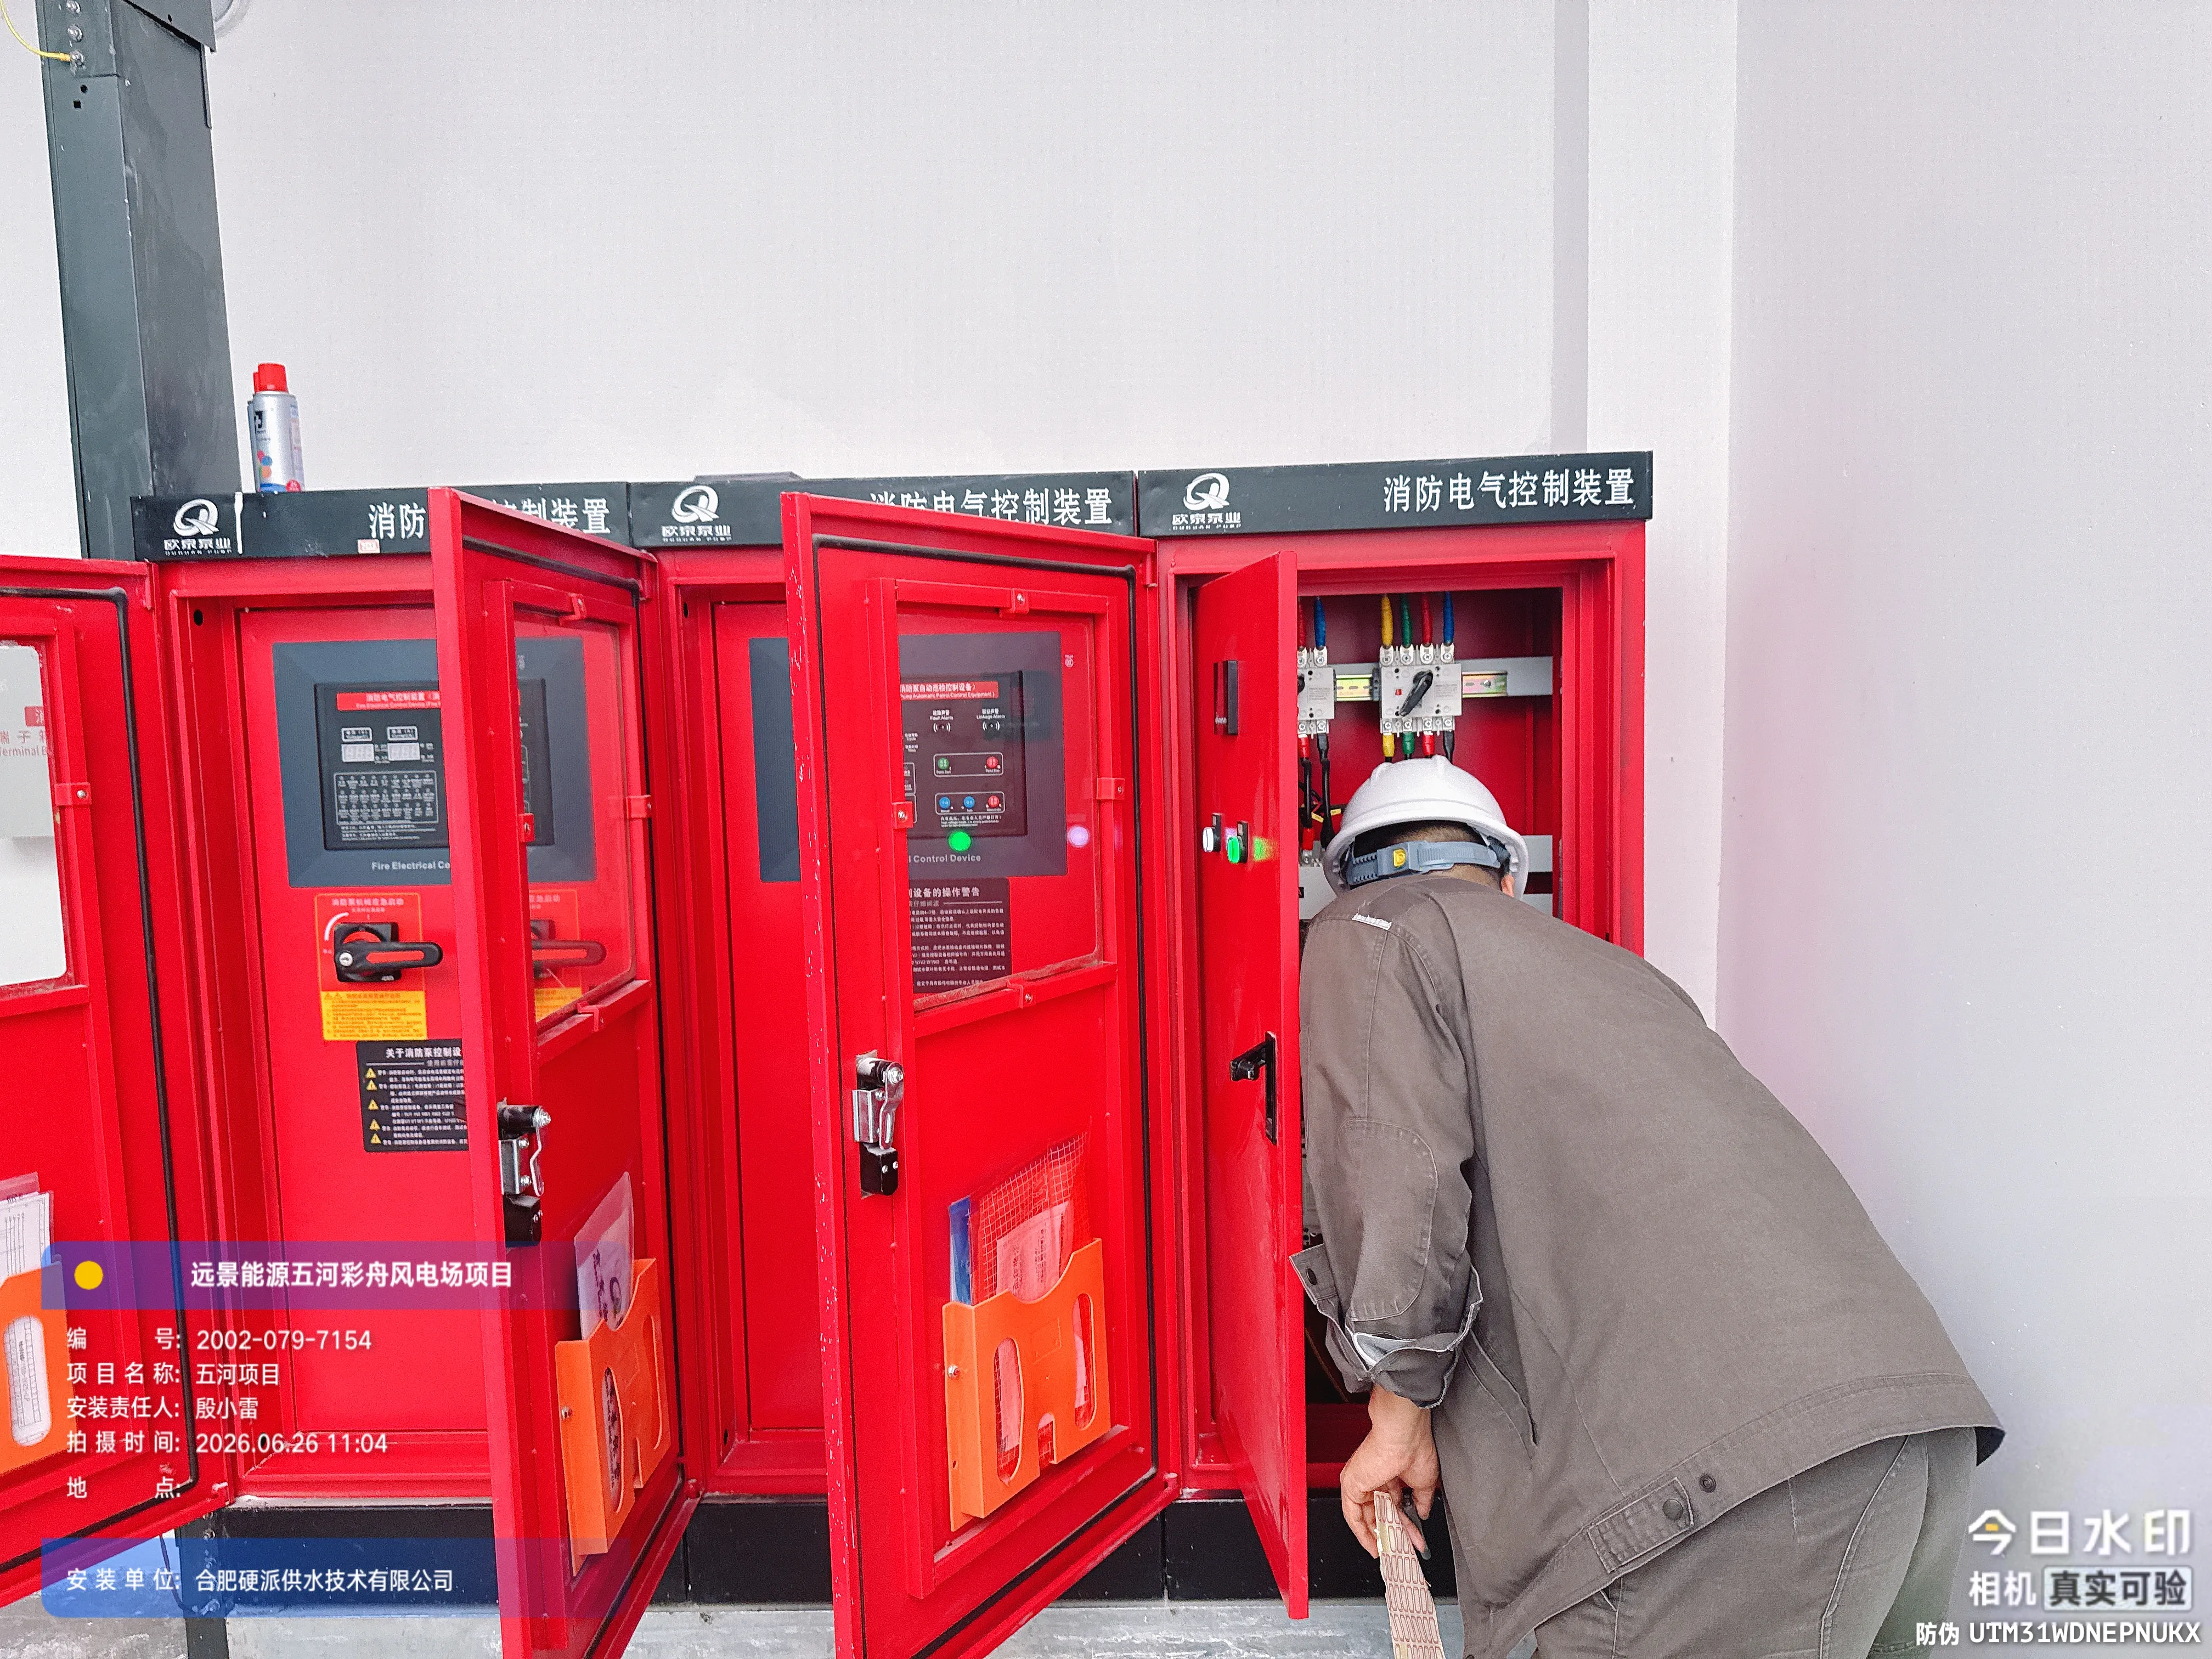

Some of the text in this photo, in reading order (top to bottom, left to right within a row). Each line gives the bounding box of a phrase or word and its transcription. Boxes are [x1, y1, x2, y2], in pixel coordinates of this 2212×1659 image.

[1384, 469, 1634, 512] 消防电气控制装置
[913, 855, 947, 863] Control
